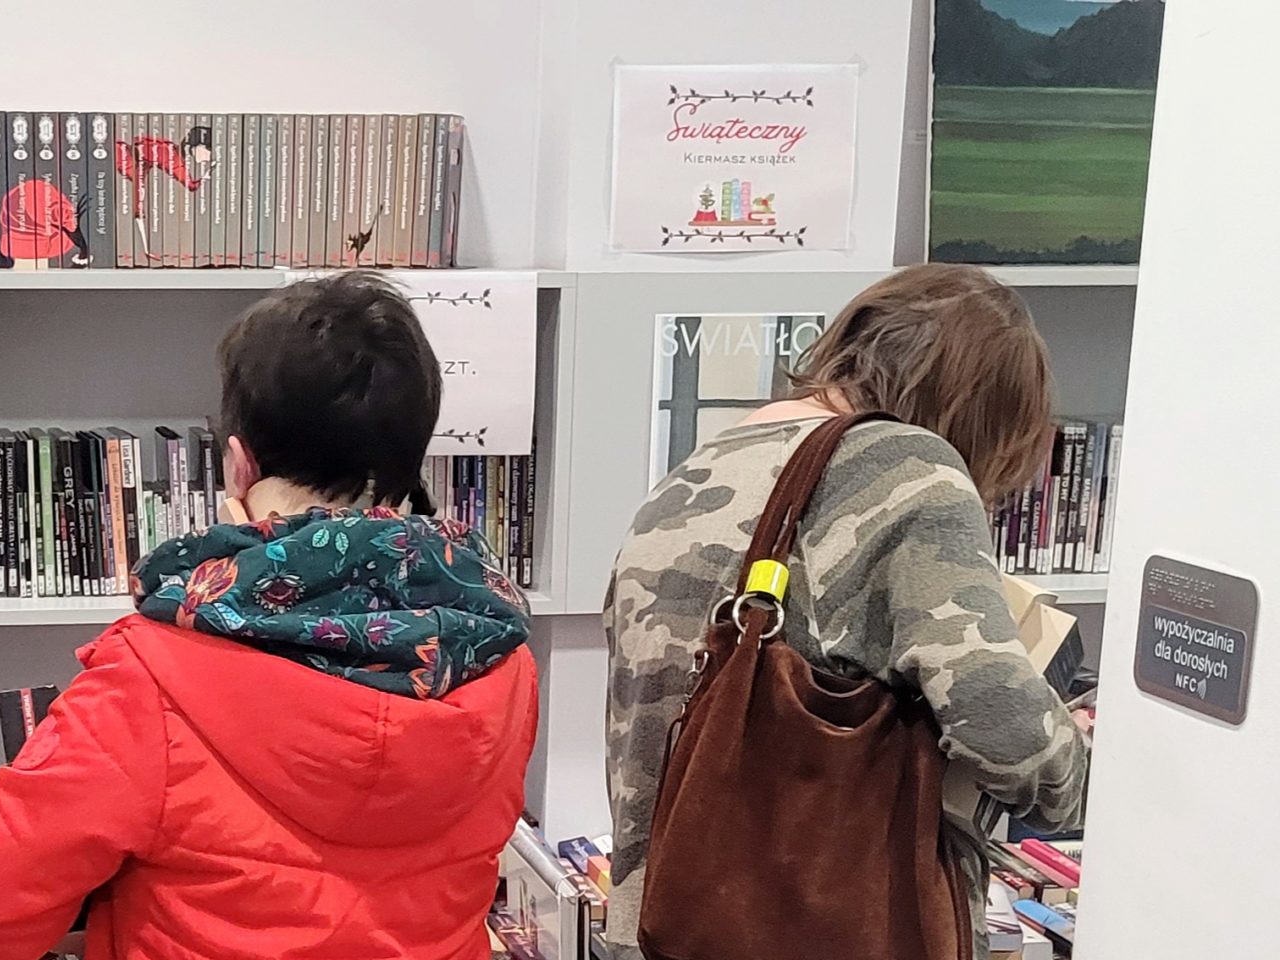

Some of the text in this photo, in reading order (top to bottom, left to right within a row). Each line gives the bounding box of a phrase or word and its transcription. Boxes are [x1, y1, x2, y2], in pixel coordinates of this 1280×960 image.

[660, 318, 823, 357] ŚWIATŁO
[439, 361, 477, 375] ZT.
[123, 445, 134, 486] Lisa Gardner
[63, 466, 75, 509] GREY
[1154, 615, 1235, 654] wypożyczalnia
[1154, 640, 1228, 680] dla dorosłych
[1175, 672, 1197, 692] NFC
